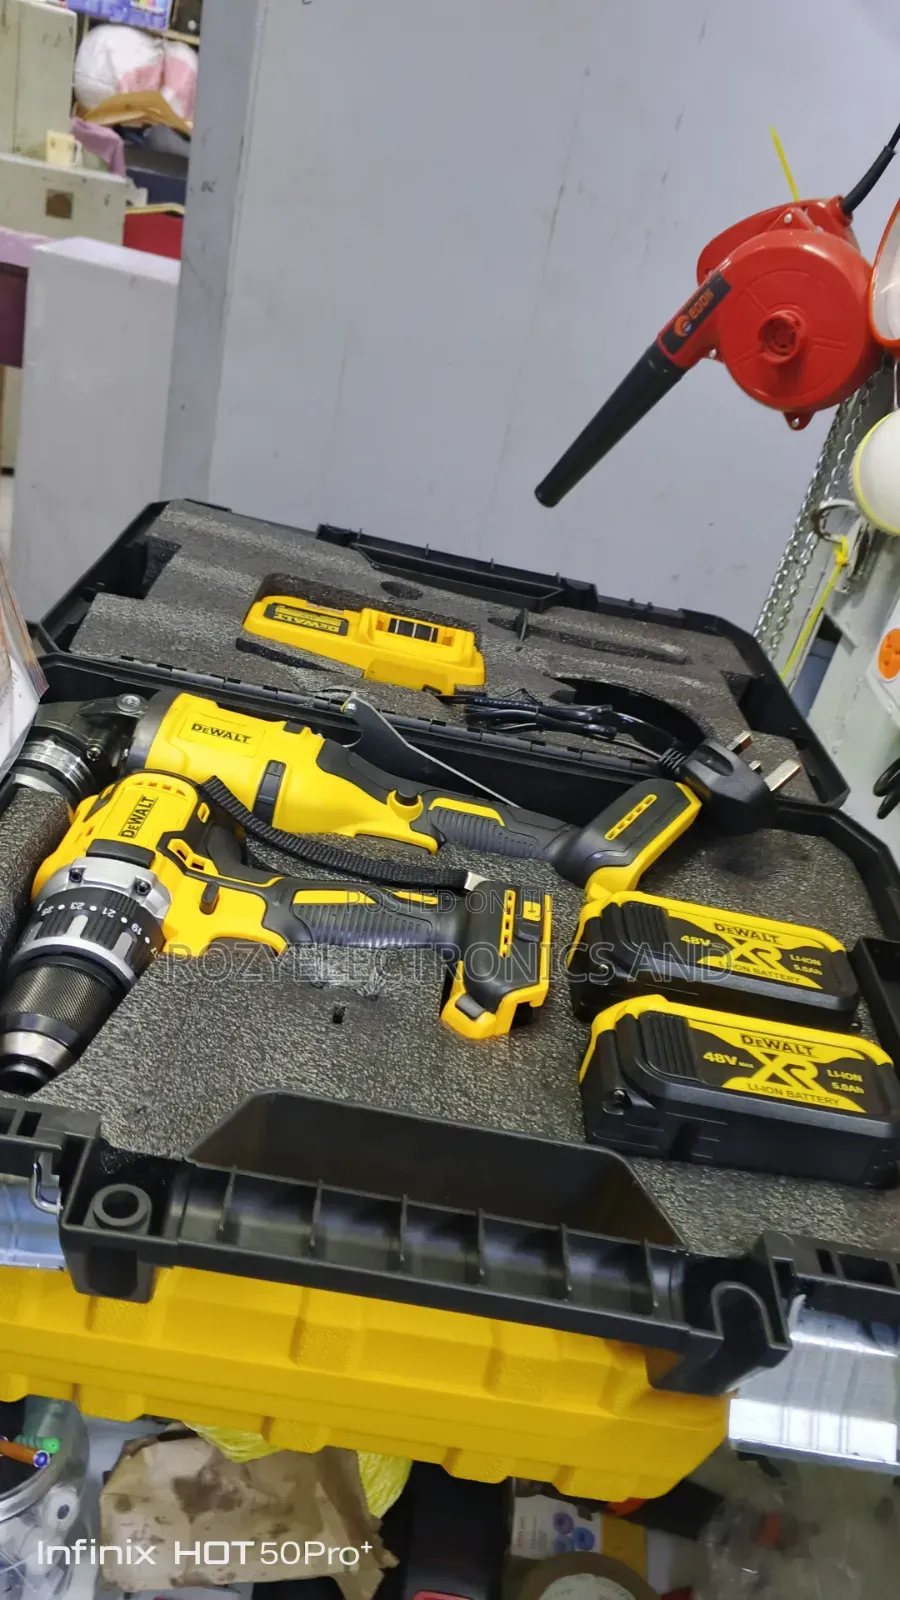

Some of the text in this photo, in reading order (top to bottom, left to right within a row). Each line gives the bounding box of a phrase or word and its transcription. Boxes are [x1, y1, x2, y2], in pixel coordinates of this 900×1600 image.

[191, 723, 252, 744] DEWALT
[119, 795, 156, 839] DEWALT
[70, 901, 86, 910] 23
[102, 907, 117, 918] 21
[131, 923, 143, 935] 19
[713, 922, 780, 945] DEWALT
[680, 935, 711, 947] 48V
[753, 968, 801, 984] BATTERY
[740, 1033, 815, 1057] DEWALT
[702, 1051, 738, 1067] 48V
[747, 1083, 840, 1107] LI-ION BATTERY
